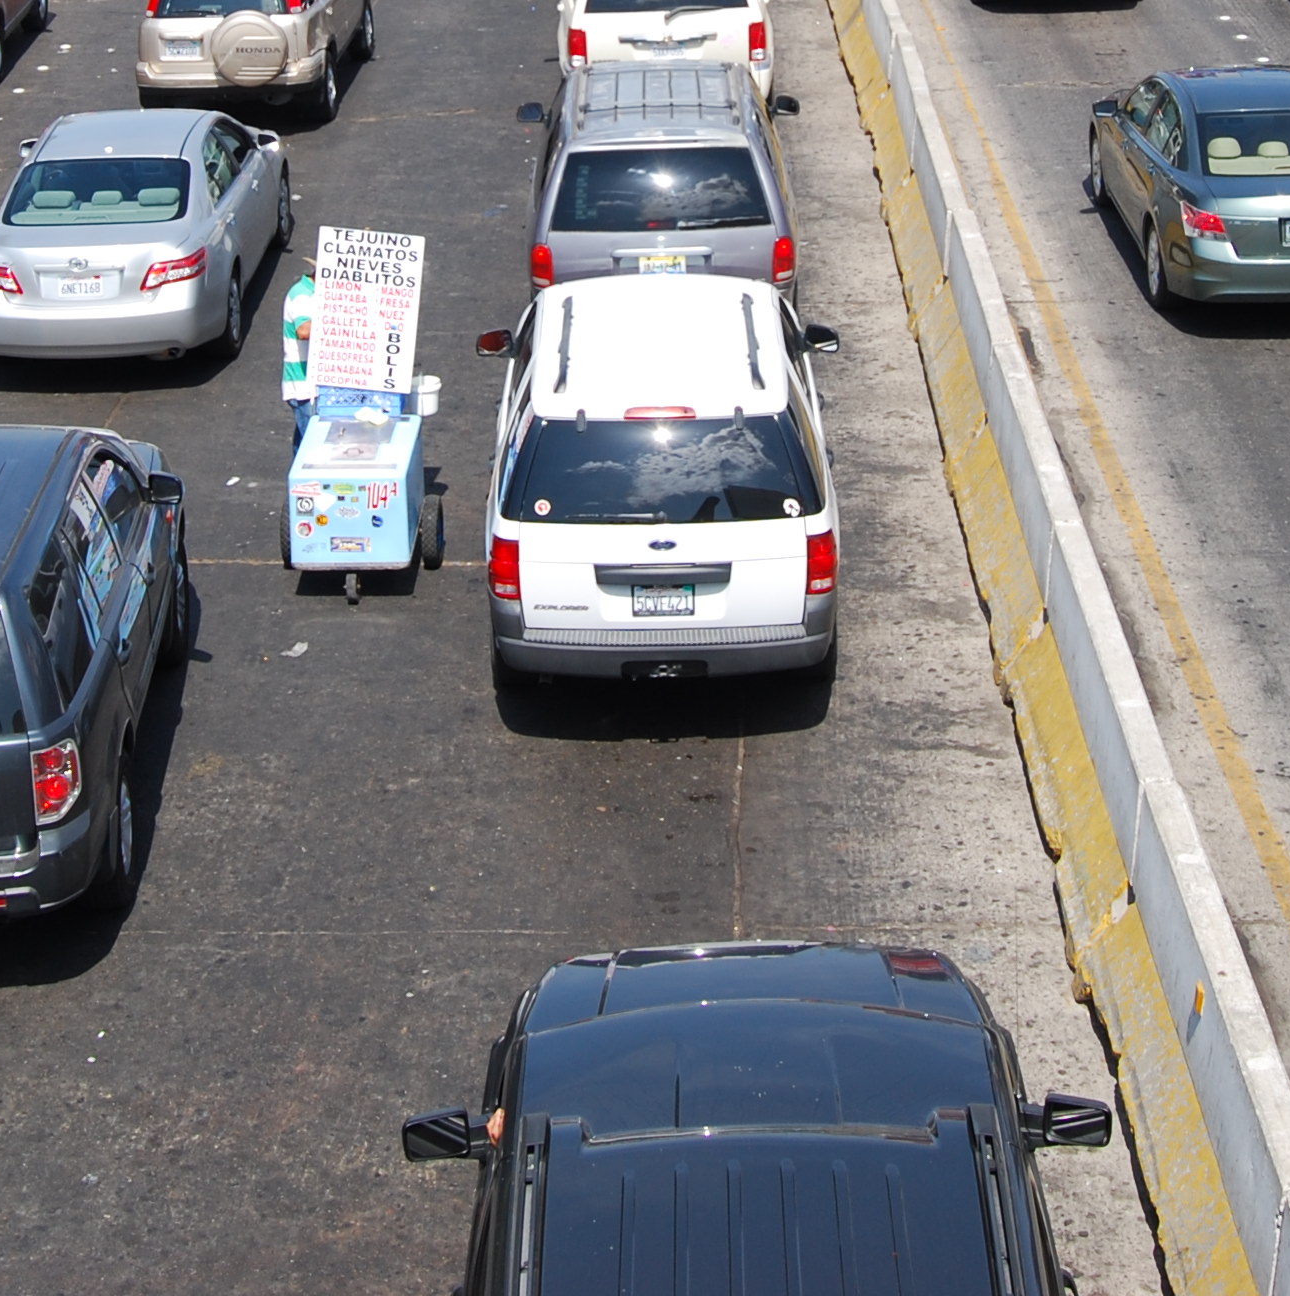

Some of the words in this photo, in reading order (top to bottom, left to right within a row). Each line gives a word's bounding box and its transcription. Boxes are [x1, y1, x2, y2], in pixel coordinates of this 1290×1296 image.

[334, 229, 412, 247] TEJUINO
[323, 242, 418, 262] CLAMATOS
[337, 257, 402, 274] NIEVES
[321, 267, 416, 288] DIABLITOS
[61, 282, 101, 295] 6NET168
[381, 286, 414, 298] MANGO
[324, 291, 367, 303] GUAYABA
[380, 297, 410, 308] FRESA
[323, 303, 368, 316] PISTACHO
[378, 310, 405, 320] NUEZ
[322, 315, 368, 327] GALLETA
[323, 327, 376, 340] VAINILLA
[320, 338, 376, 352] TAMARINDO
[317, 363, 373, 376] GUANABANA
[384, 333, 401, 389] BOLIS
